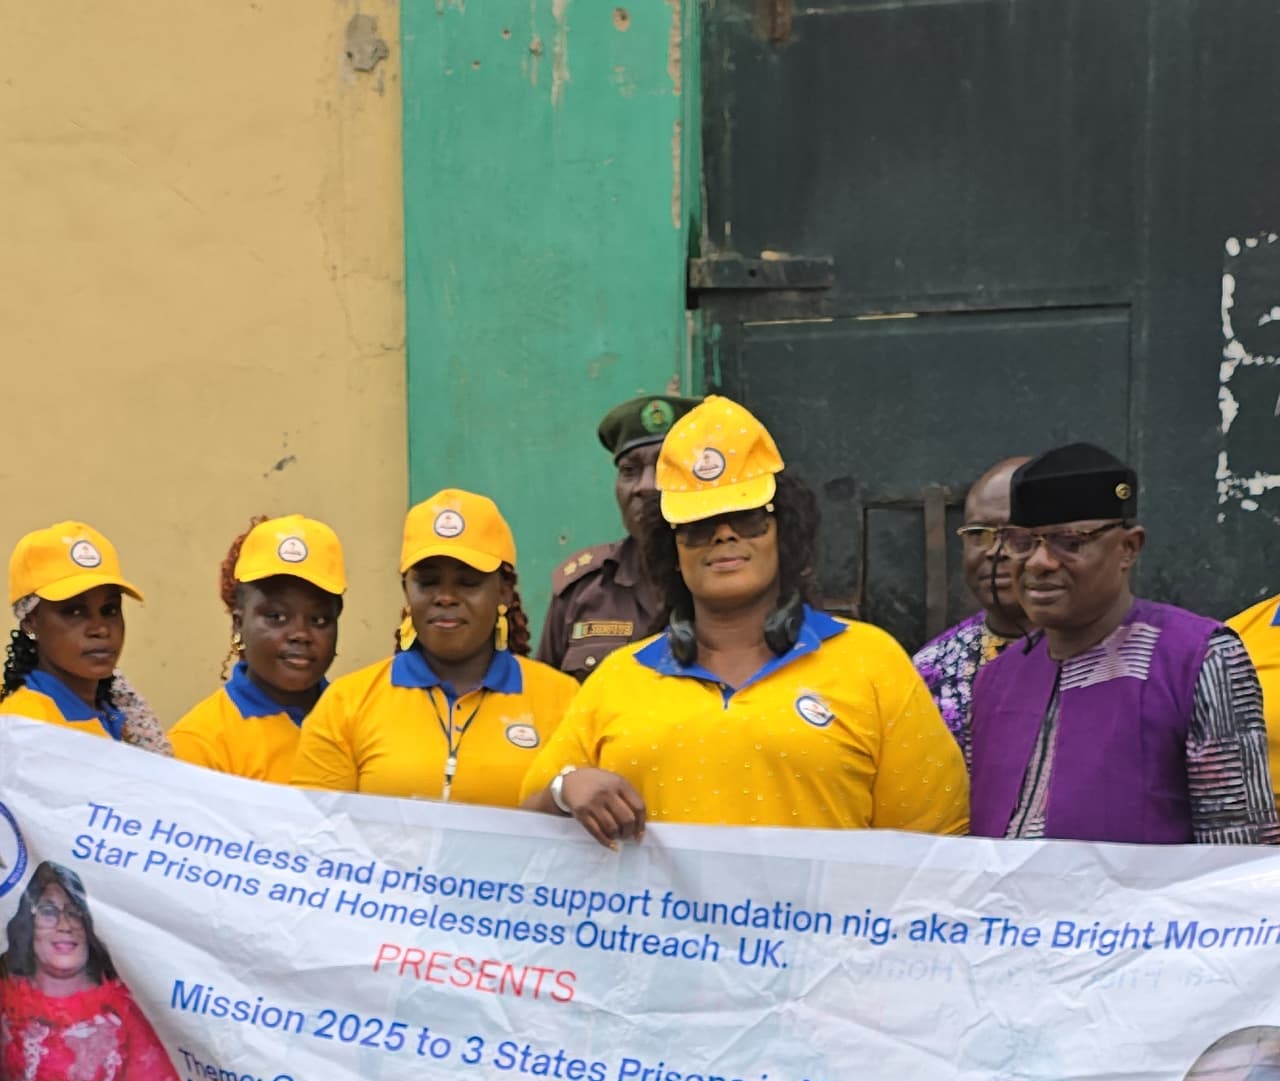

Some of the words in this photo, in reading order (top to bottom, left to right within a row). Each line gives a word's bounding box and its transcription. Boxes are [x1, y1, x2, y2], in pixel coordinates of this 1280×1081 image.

[71, 834, 138, 868] Star
[143, 850, 261, 896] Prisons
[268, 882, 329, 909] and
[335, 890, 565, 945] Homelessness
[575, 920, 720, 962] Outreach
[737, 937, 788, 969] UK.
[88, 802, 142, 836] The
[150, 818, 309, 874] Homeless
[316, 858, 376, 885] and
[380, 866, 525, 904] prisoners
[532, 884, 652, 918] support
[660, 891, 833, 935] foundation
[842, 909, 898, 946] nig.
[908, 912, 970, 944] aka
[980, 917, 1041, 947] The
[1051, 920, 1155, 957] Bright
[171, 980, 306, 1034] Mission
[313, 1008, 408, 1052] 2025
[417, 1027, 452, 1059] to
[461, 1036, 484, 1064] 3
[373, 943, 577, 1004] PRESENTS
